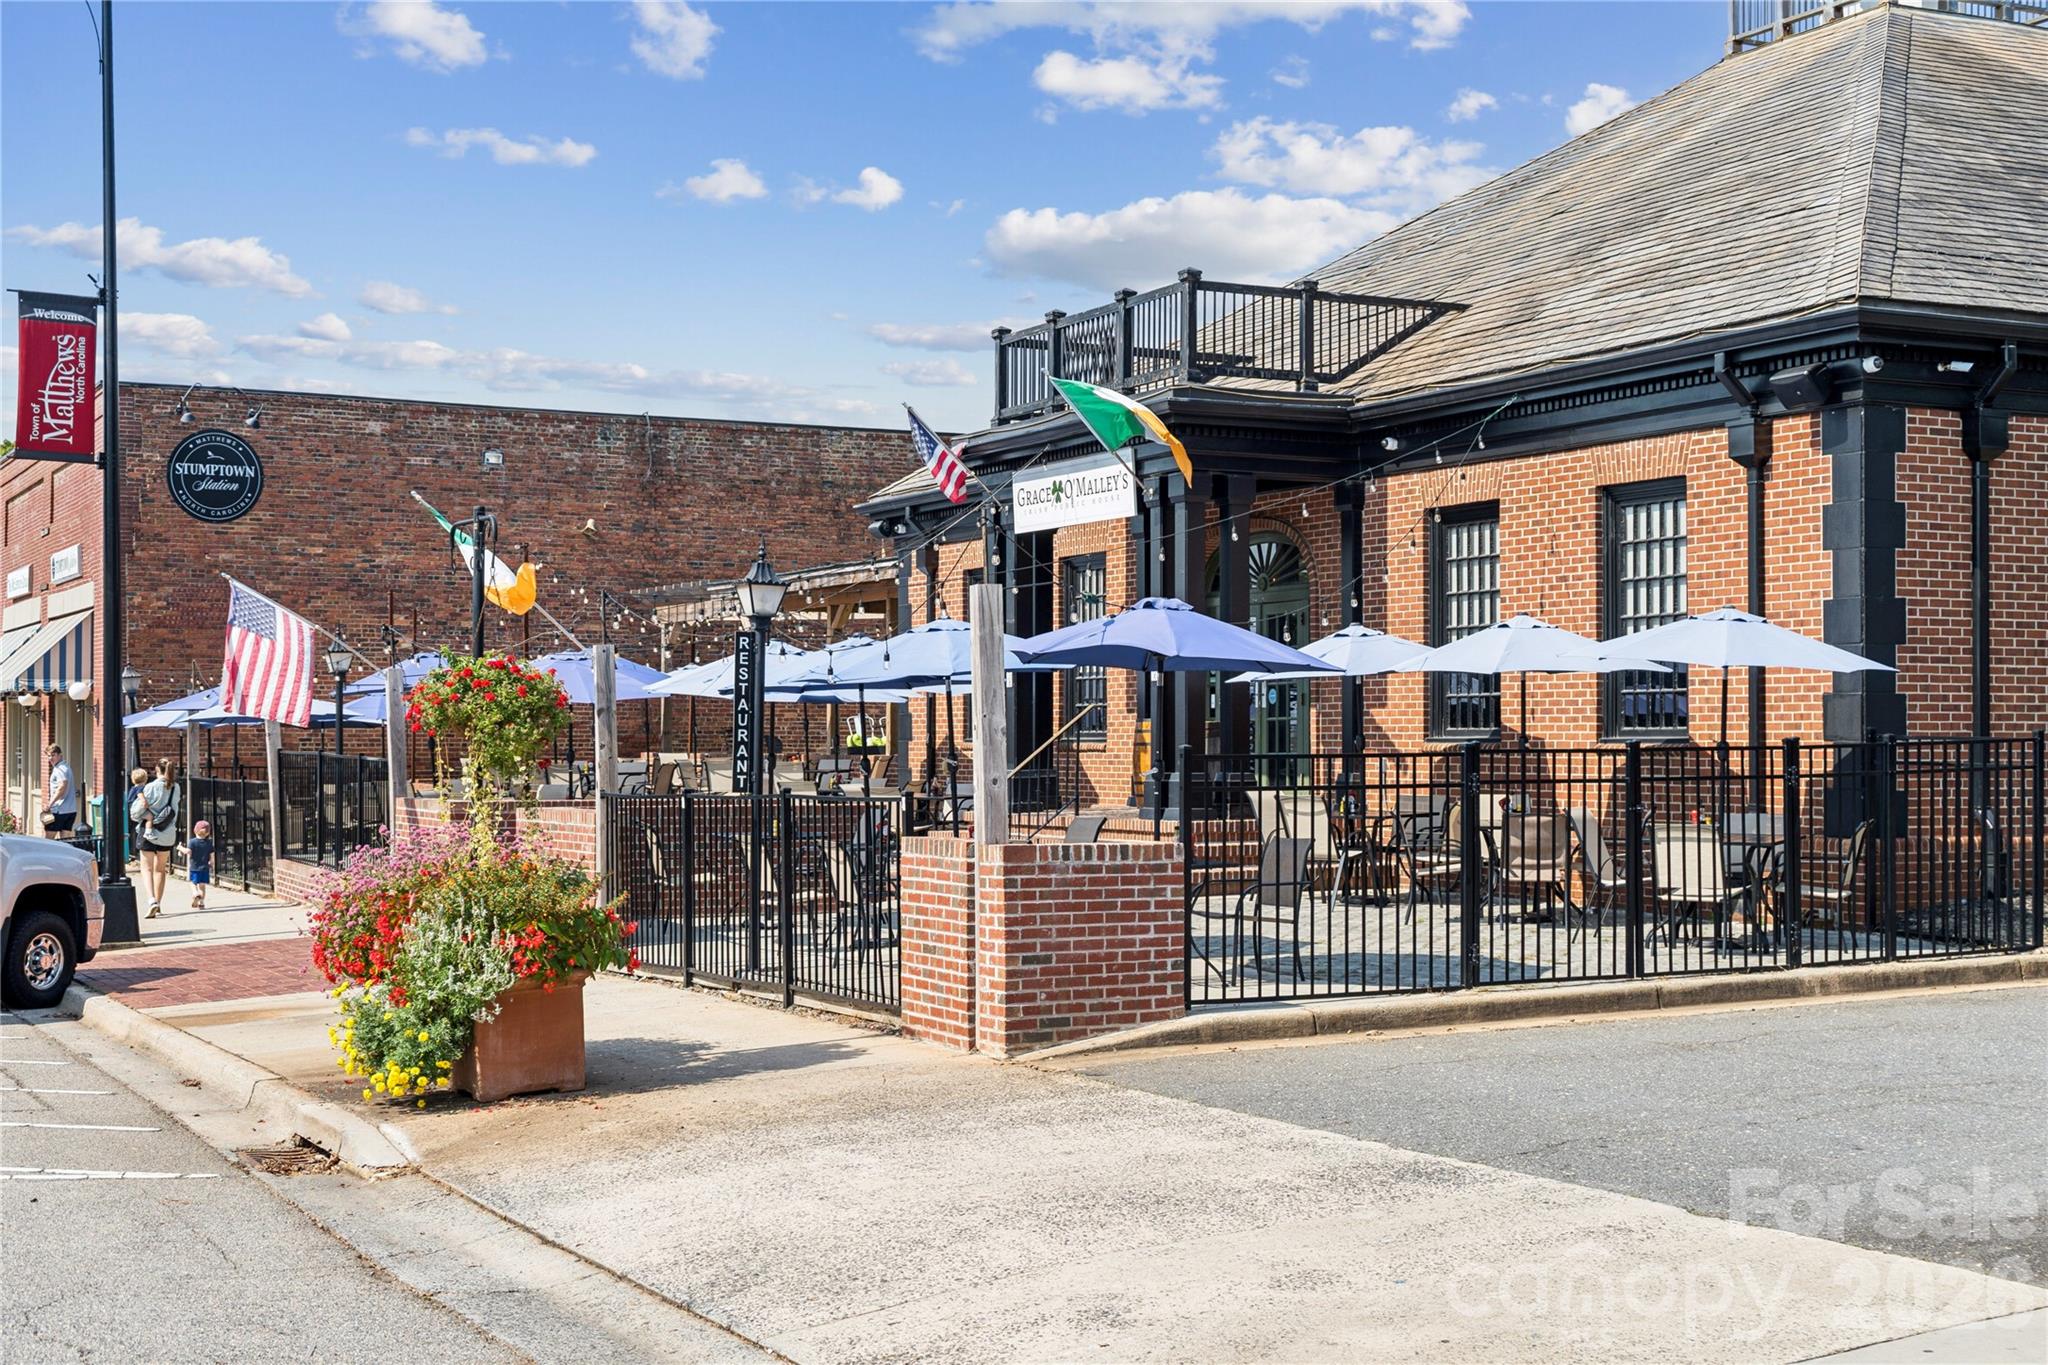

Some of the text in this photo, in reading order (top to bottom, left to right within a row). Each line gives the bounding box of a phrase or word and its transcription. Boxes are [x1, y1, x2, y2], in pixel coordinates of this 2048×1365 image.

[33, 308, 85, 322] Welcome
[76, 336, 86, 403] North Carolina
[38, 334, 76, 444] Matthews
[30, 402, 41, 442] Town of
[195, 436, 237, 447] MATTHEWS
[175, 462, 255, 478] STUMPTOWN
[192, 477, 239, 492] Station
[181, 494, 250, 516] NORTH CAROLINA
[1017, 487, 1052, 507] GRACE
[737, 636, 750, 788] RESTAURANT
